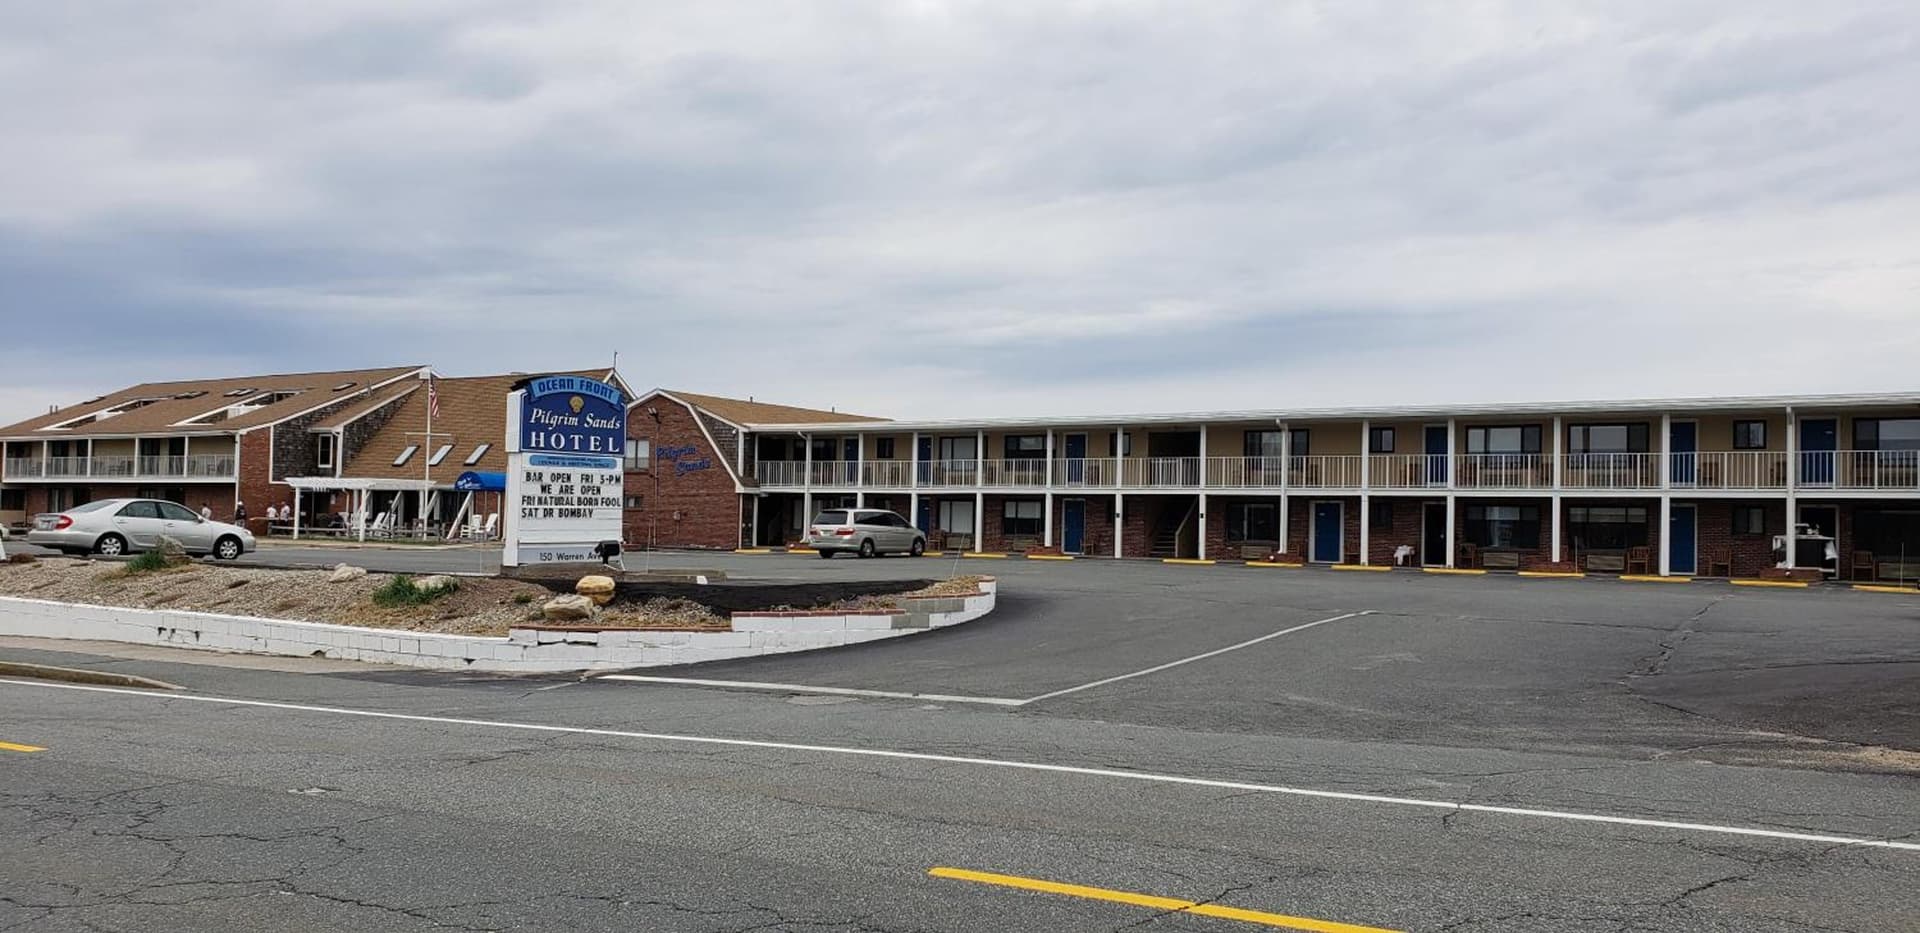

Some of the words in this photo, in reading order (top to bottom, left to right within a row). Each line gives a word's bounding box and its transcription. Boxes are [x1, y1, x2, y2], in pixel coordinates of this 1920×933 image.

[538, 378, 574, 393] OCEAN
[580, 379, 615, 400] FRONT
[530, 408, 578, 430] Pilgrim
[584, 413, 620, 429] Sands
[530, 432, 619, 452] HOTEL
[526, 472, 543, 482] BAR
[550, 473, 571, 483] OPEN
[580, 474, 593, 484] FRI
[541, 484, 552, 494] WE
[559, 485, 574, 494] ARE
[581, 486, 601, 495] OPEN
[521, 496, 535, 506] FRI
[537, 496, 575, 506] NATURAL
[577, 497, 598, 507] BORN
[601, 497, 621, 507] FOOL
[522, 508, 539, 518] SAT
[543, 508, 554, 518] DR
[559, 508, 593, 518] BOMBAY
